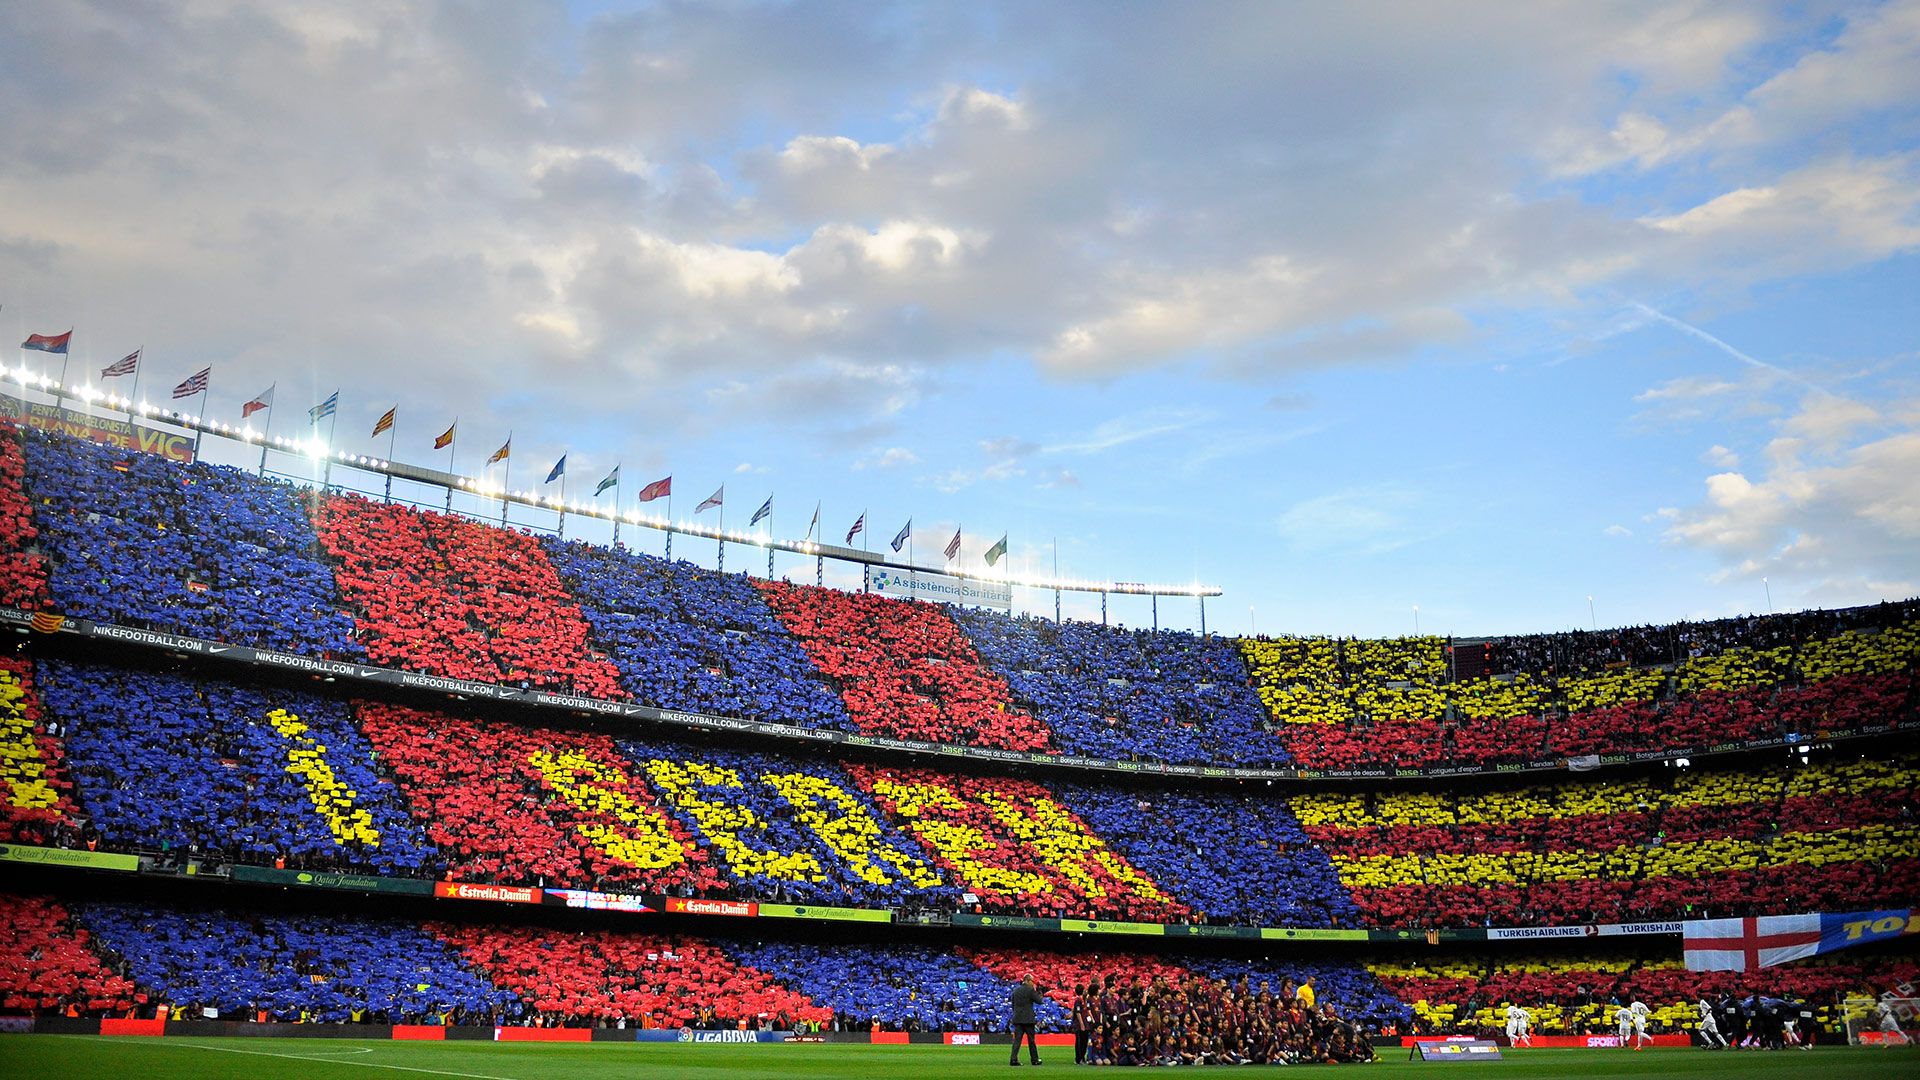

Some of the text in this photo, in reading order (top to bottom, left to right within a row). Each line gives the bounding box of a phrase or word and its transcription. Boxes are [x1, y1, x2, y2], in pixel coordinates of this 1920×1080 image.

[31, 404, 61, 419] PENYA
[67, 411, 131, 435] BARCELONISTA
[28, 416, 129, 448] PLANA DE
[137, 427, 187, 460] VIC
[893, 576, 960, 596] Assistència
[93, 625, 202, 652] NIKEFOOTBALL.COM
[255, 651, 354, 676] NIKEFOOTBALL.COM
[402, 674, 494, 696] NIKEFOOTBALL.COM
[536, 693, 621, 713] NIKEFOOTBALL.COM
[659, 711, 738, 729] NIKEFOOTBALL.COM
[759, 724, 833, 740] NIKEFOOTBALL.COM
[1829, 729, 1856, 738] ase:
[879, 737, 905, 748] Botigues
[1744, 739, 1772, 748] Tiendas
[971, 747, 992, 758] Tiendas
[993, 750, 1000, 758] de
[1001, 751, 1023, 761] deporte
[1636, 750, 1665, 760] Botigues
[1667, 747, 1694, 756] d'esport
[1060, 756, 1084, 766] Botigues
[1530, 760, 1554, 768] Tiendas
[1174, 766, 1195, 774] deporte
[1234, 768, 1259, 778] Botigues
[1328, 769, 1351, 778] Tiendas
[1352, 769, 1361, 778] de
[1362, 769, 1386, 779] deporte
[12, 847, 90, 863] Qatar Foundation
[314, 874, 378, 888] Qatar Foundation
[459, 884, 531, 902] Estrella Damm
[686, 899, 749, 916] Estrella Damm
[807, 908, 824, 917] Qatar
[1497, 927, 1580, 938] TURKISH AIRLINES
[1621, 924, 1663, 934] TURKISH
[1587, 1037, 1619, 1047] SPORT
